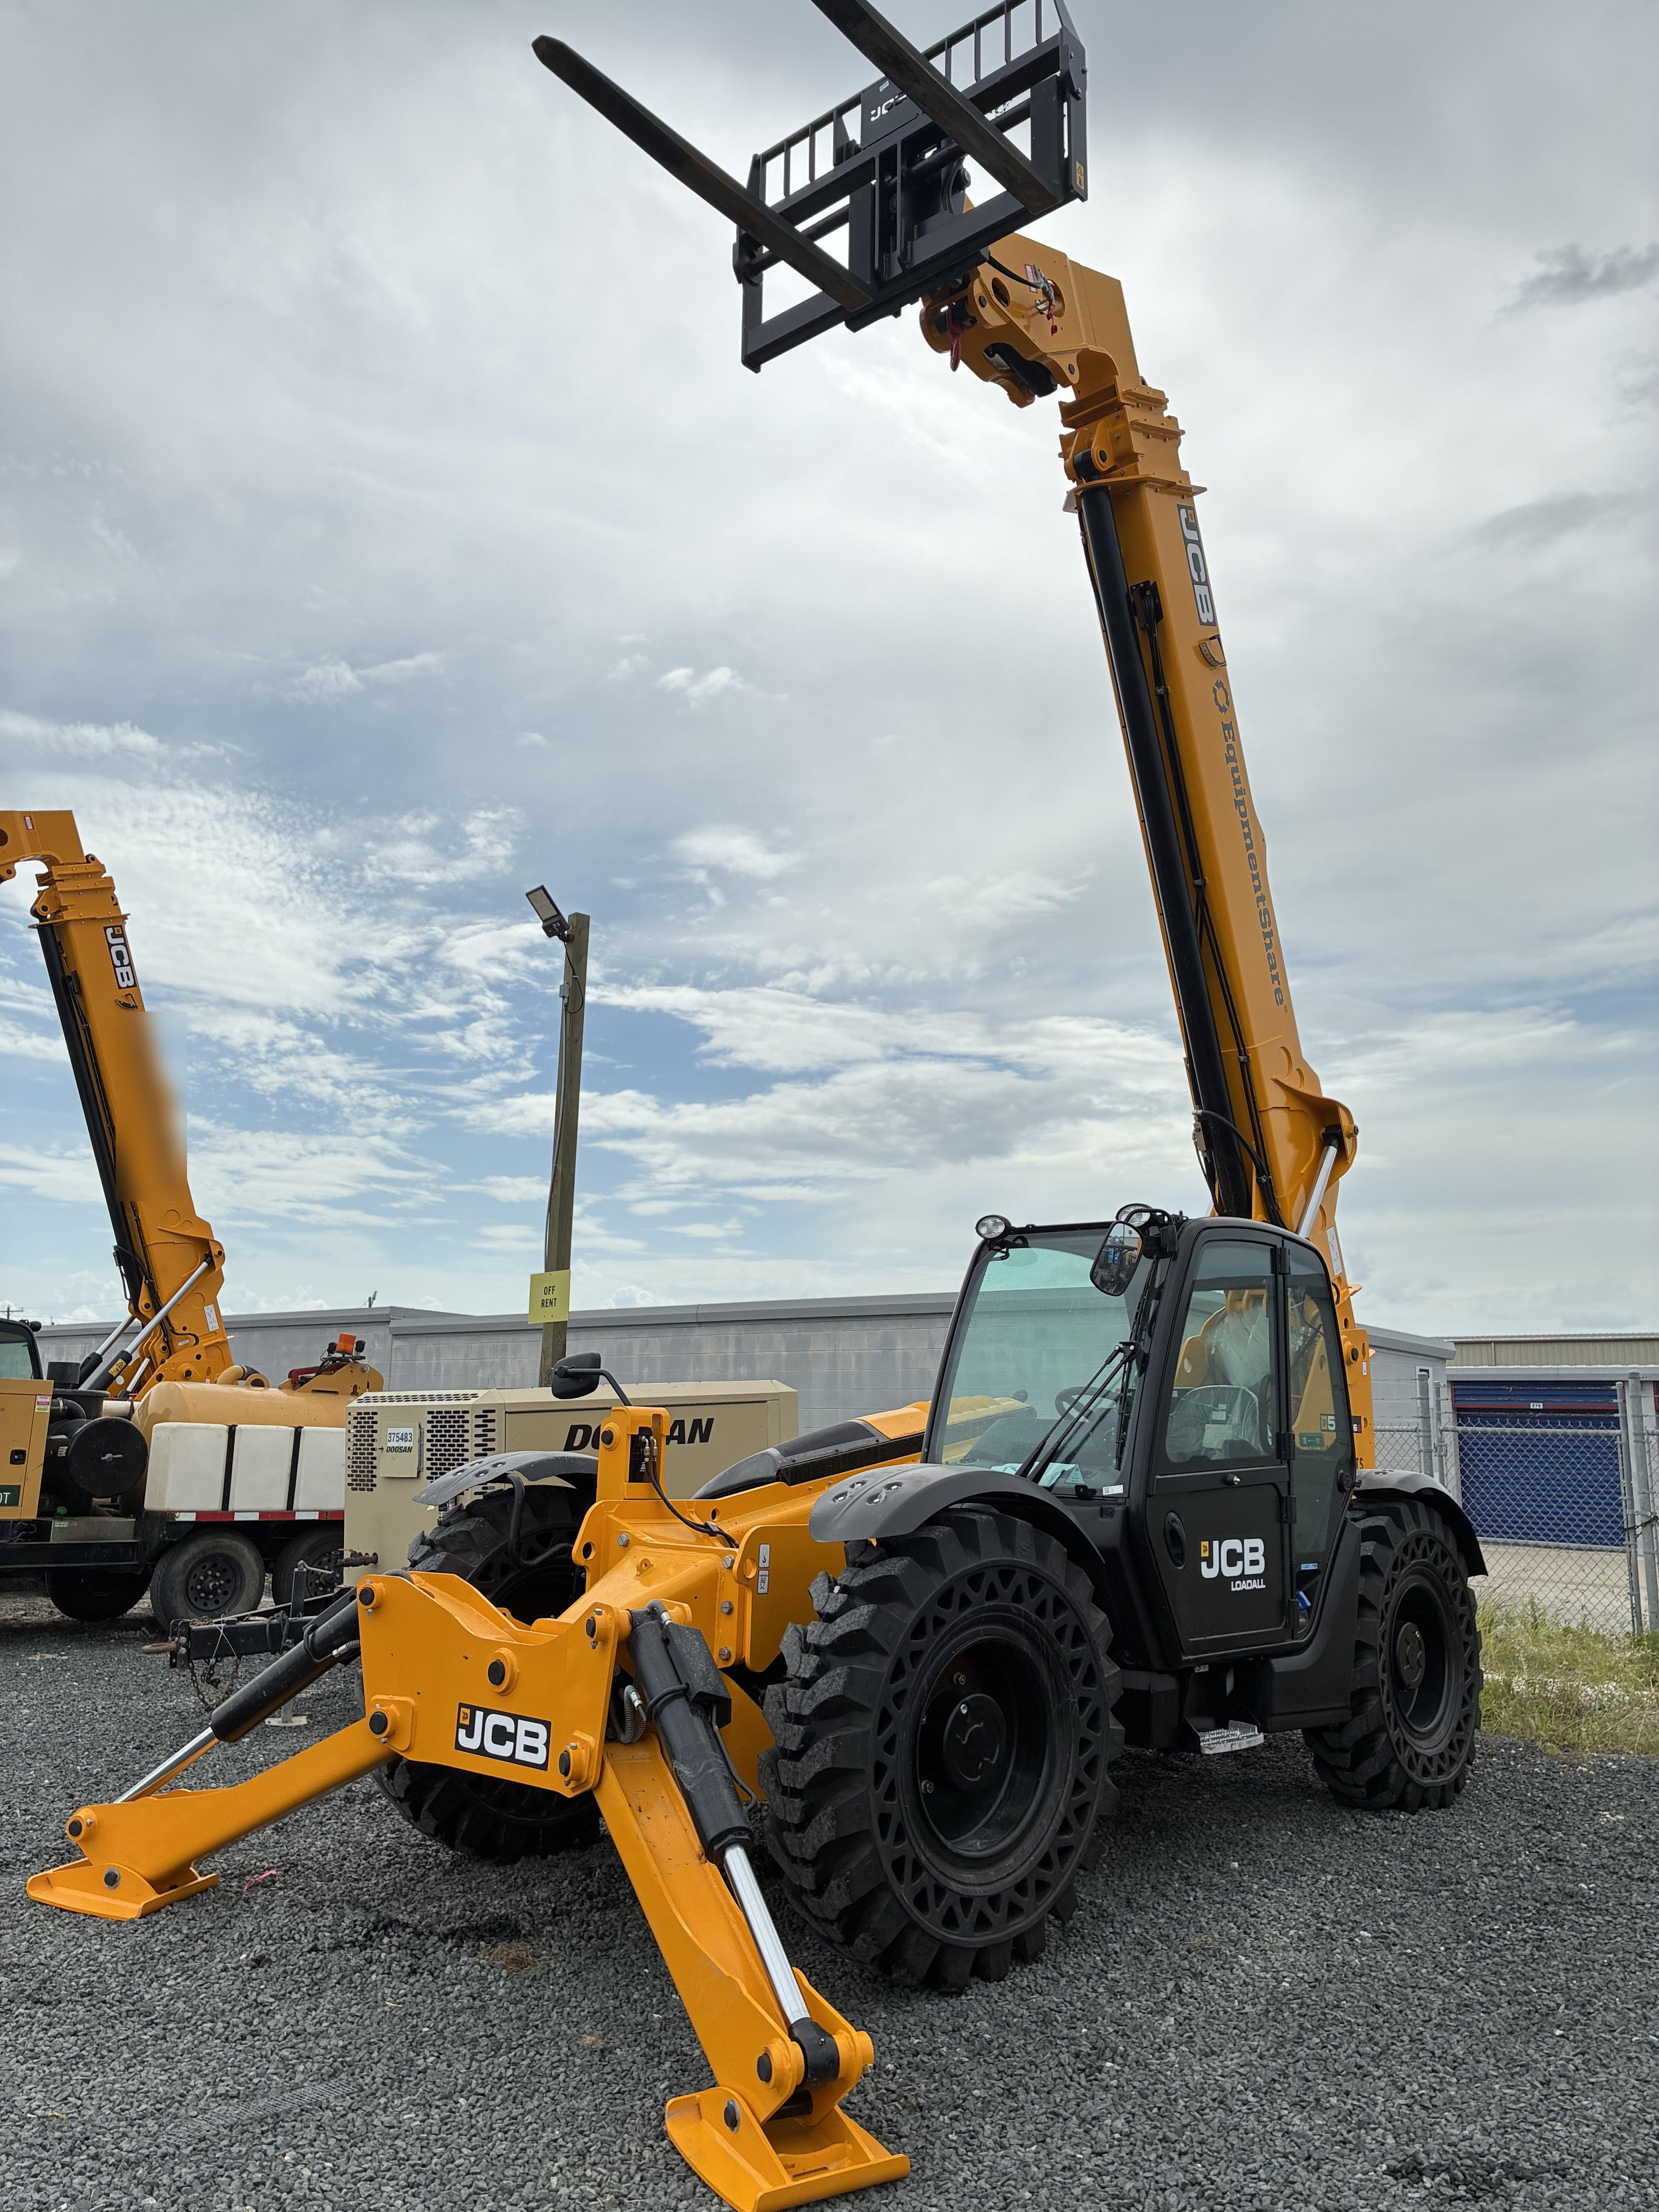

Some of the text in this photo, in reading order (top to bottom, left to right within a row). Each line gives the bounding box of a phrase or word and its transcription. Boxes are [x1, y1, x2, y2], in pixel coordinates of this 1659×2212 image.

[1180, 508, 1213, 623] JCB
[106, 928, 134, 988] JCB
[541, 1298, 557, 1308] RENT
[544, 1286, 556, 1295] OFF
[388, 1432, 412, 1442] 375483
[563, 1418, 714, 1451] DAN
[1201, 1538, 1265, 1578] JCB
[1231, 1579, 1266, 1591] LOADALL
[458, 1710, 547, 1764] JCB
